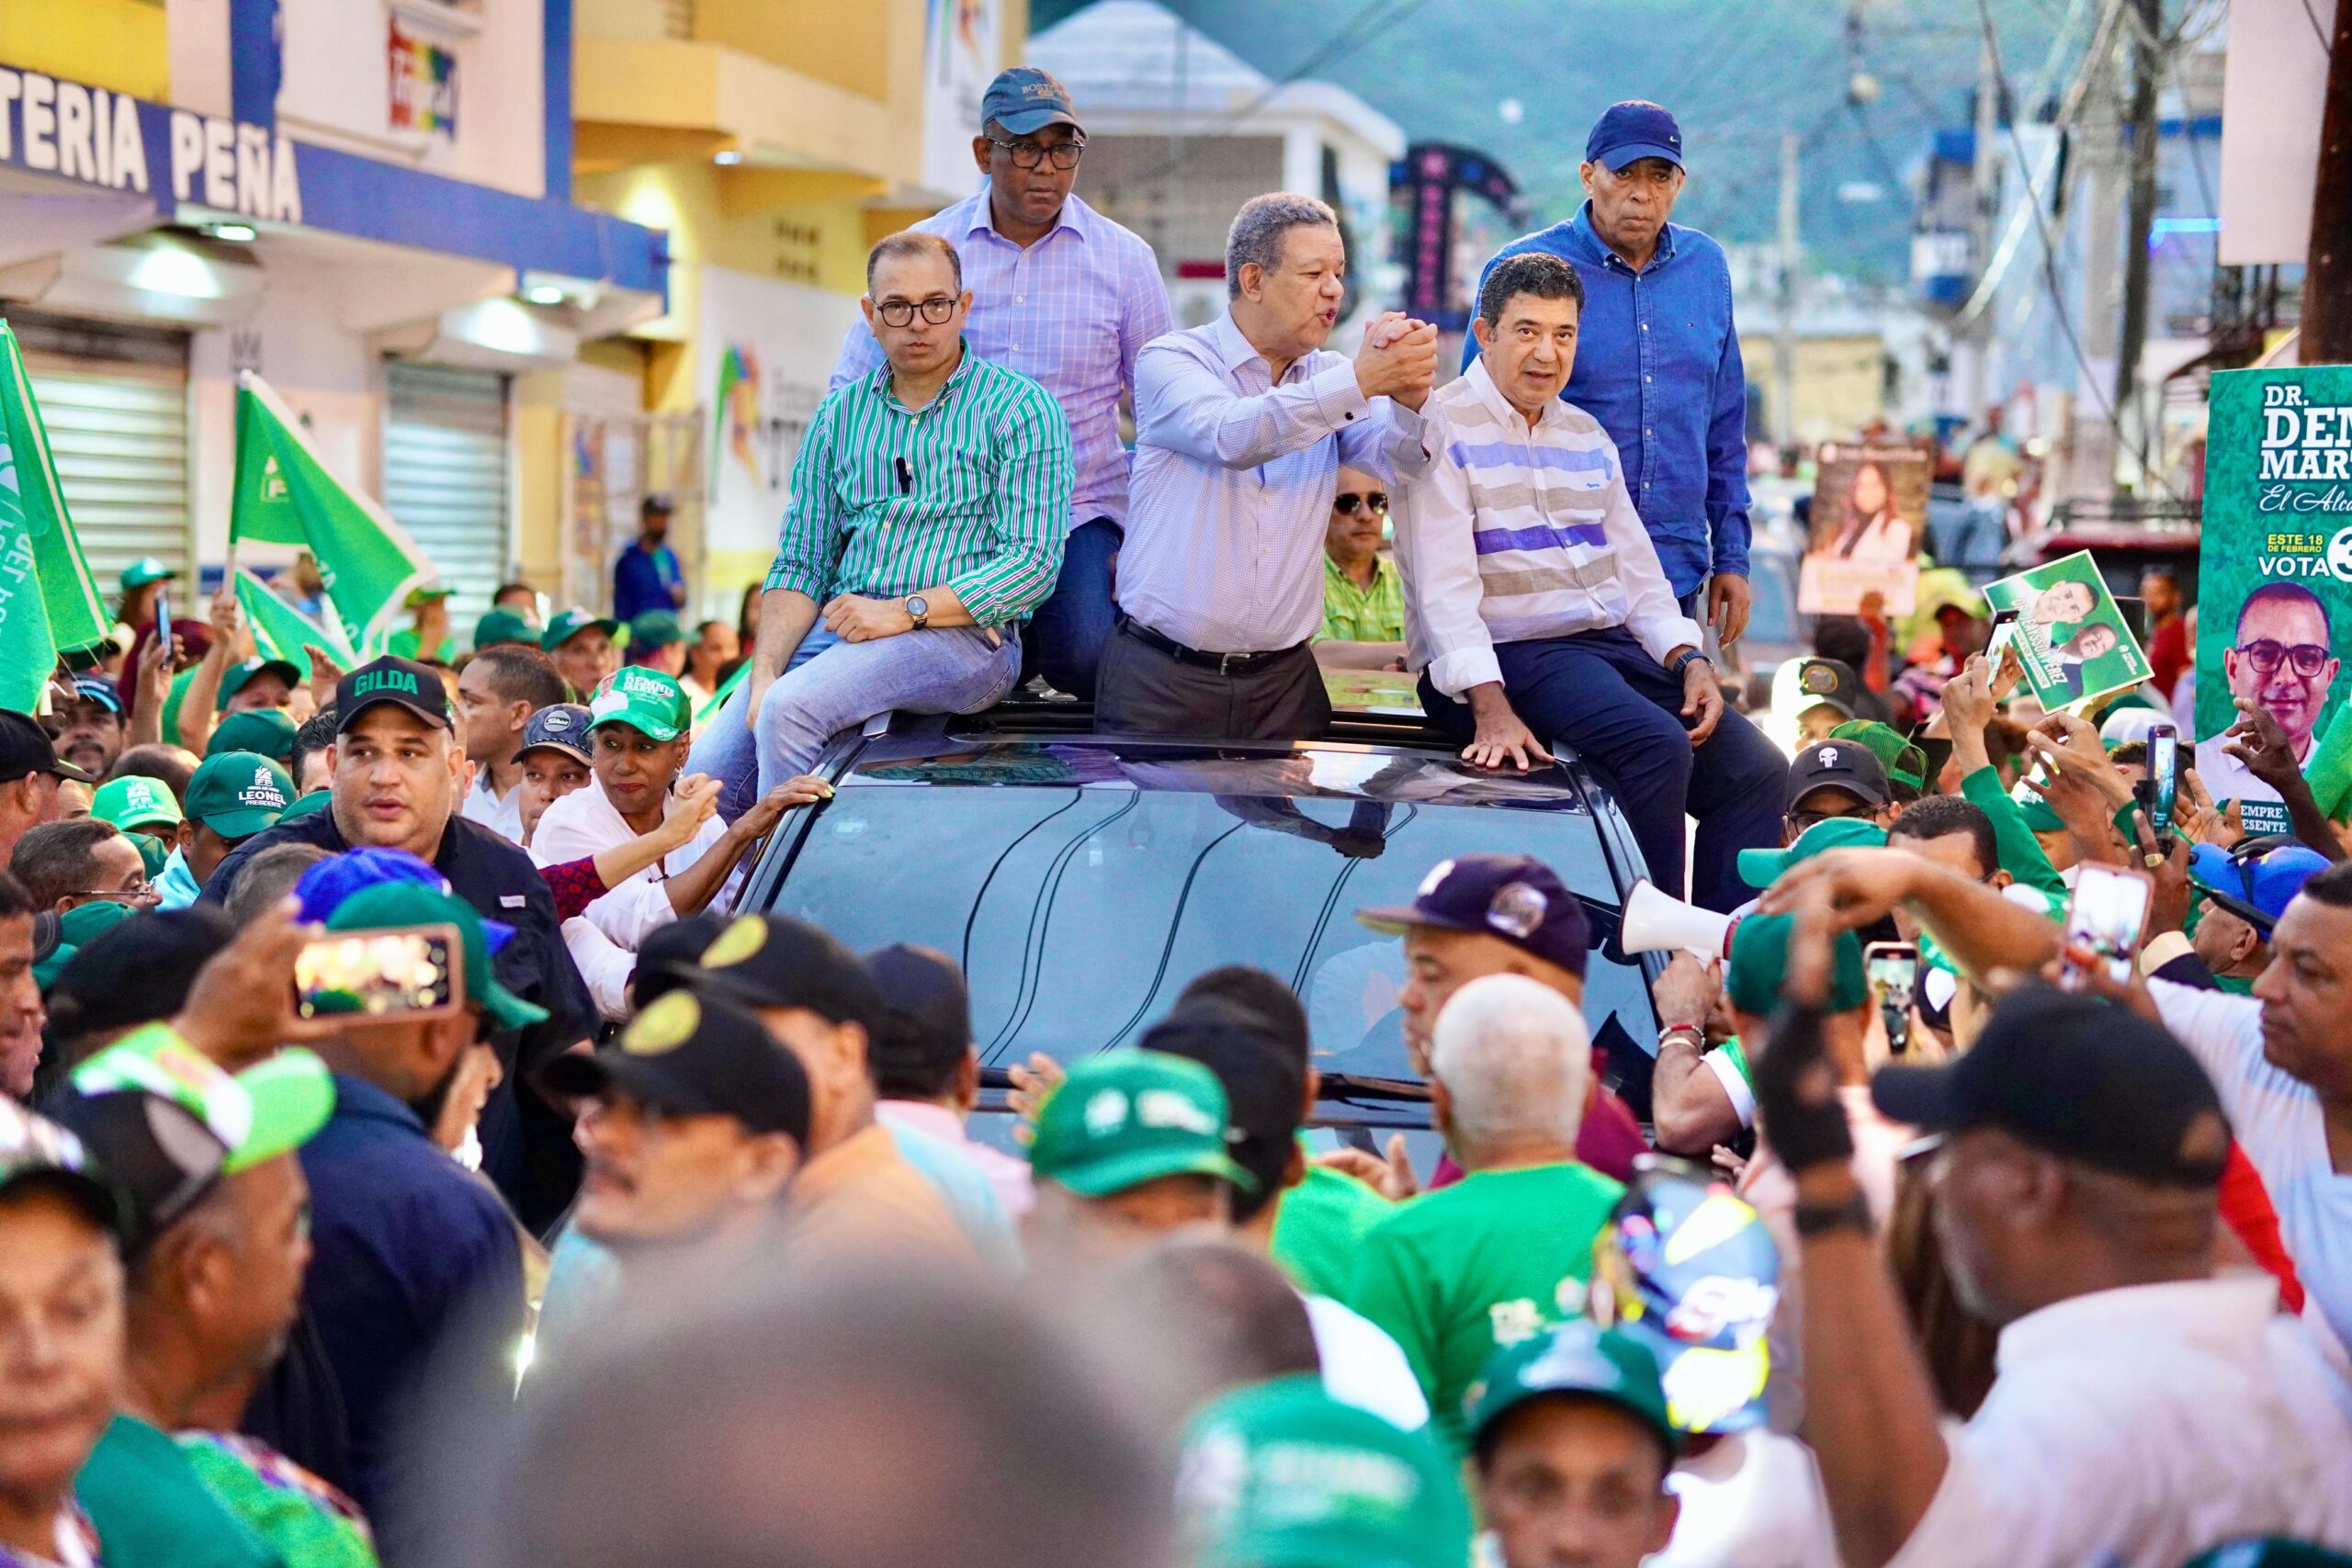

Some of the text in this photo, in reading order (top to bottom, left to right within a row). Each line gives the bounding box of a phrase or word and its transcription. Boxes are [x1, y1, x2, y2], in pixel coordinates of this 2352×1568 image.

[0, 67, 302, 224] TERIA PEÑA
[2265, 385, 2309, 406] DR.
[2259, 449, 2352, 479] MAR
[2259, 484, 2292, 511] El
[2267, 534, 2324, 545] ESTE 18
[2258, 557, 2331, 577] VOTA
[354, 670, 418, 696] GILDA
[239, 791, 287, 805] LEONEL
[245, 800, 282, 809] PRESIDENTE
[2241, 805, 2283, 818] EMPRE
[2242, 818, 2287, 832] ESENTE
